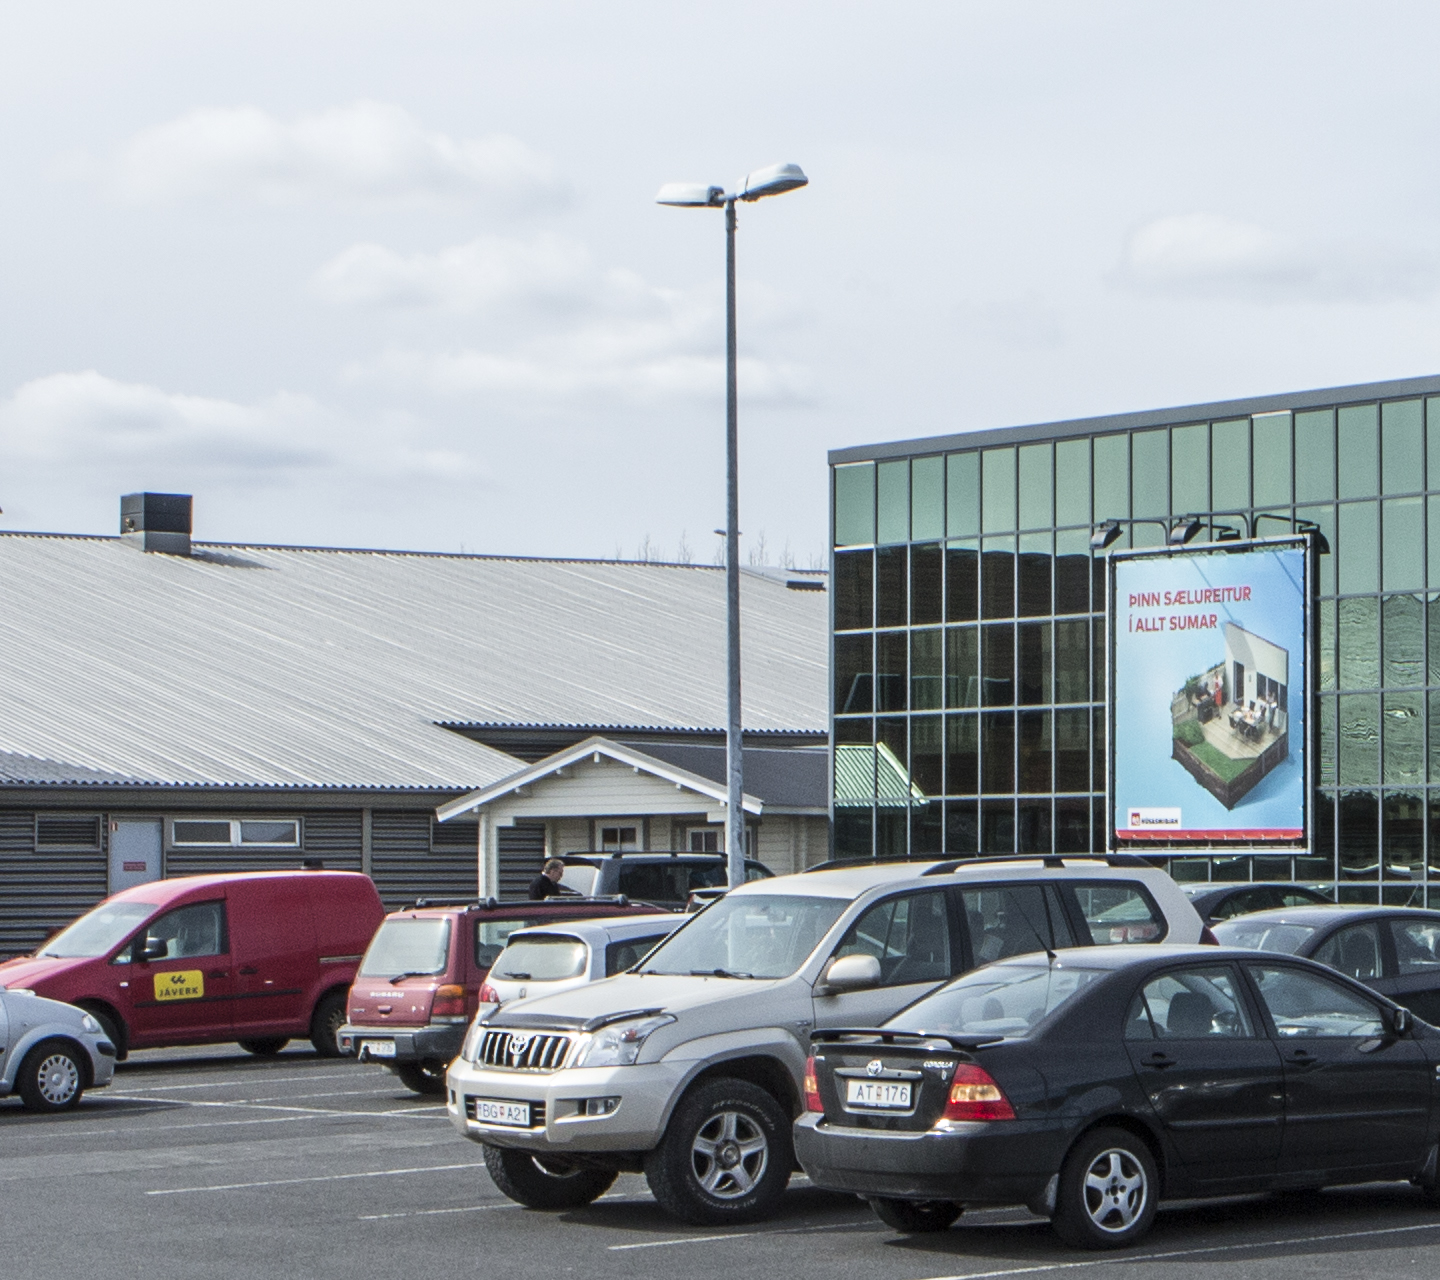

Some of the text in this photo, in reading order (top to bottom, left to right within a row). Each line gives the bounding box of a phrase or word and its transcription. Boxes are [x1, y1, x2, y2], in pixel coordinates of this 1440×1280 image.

[1128, 585, 1252, 608] ÞINN SÆLUREITUR
[1128, 613, 1218, 632] Í ALLT SUMAR
[159, 985, 198, 997] JÁVERK
[856, 1085, 909, 1103] AT 176
[482, 1104, 528, 1123] BG A21
